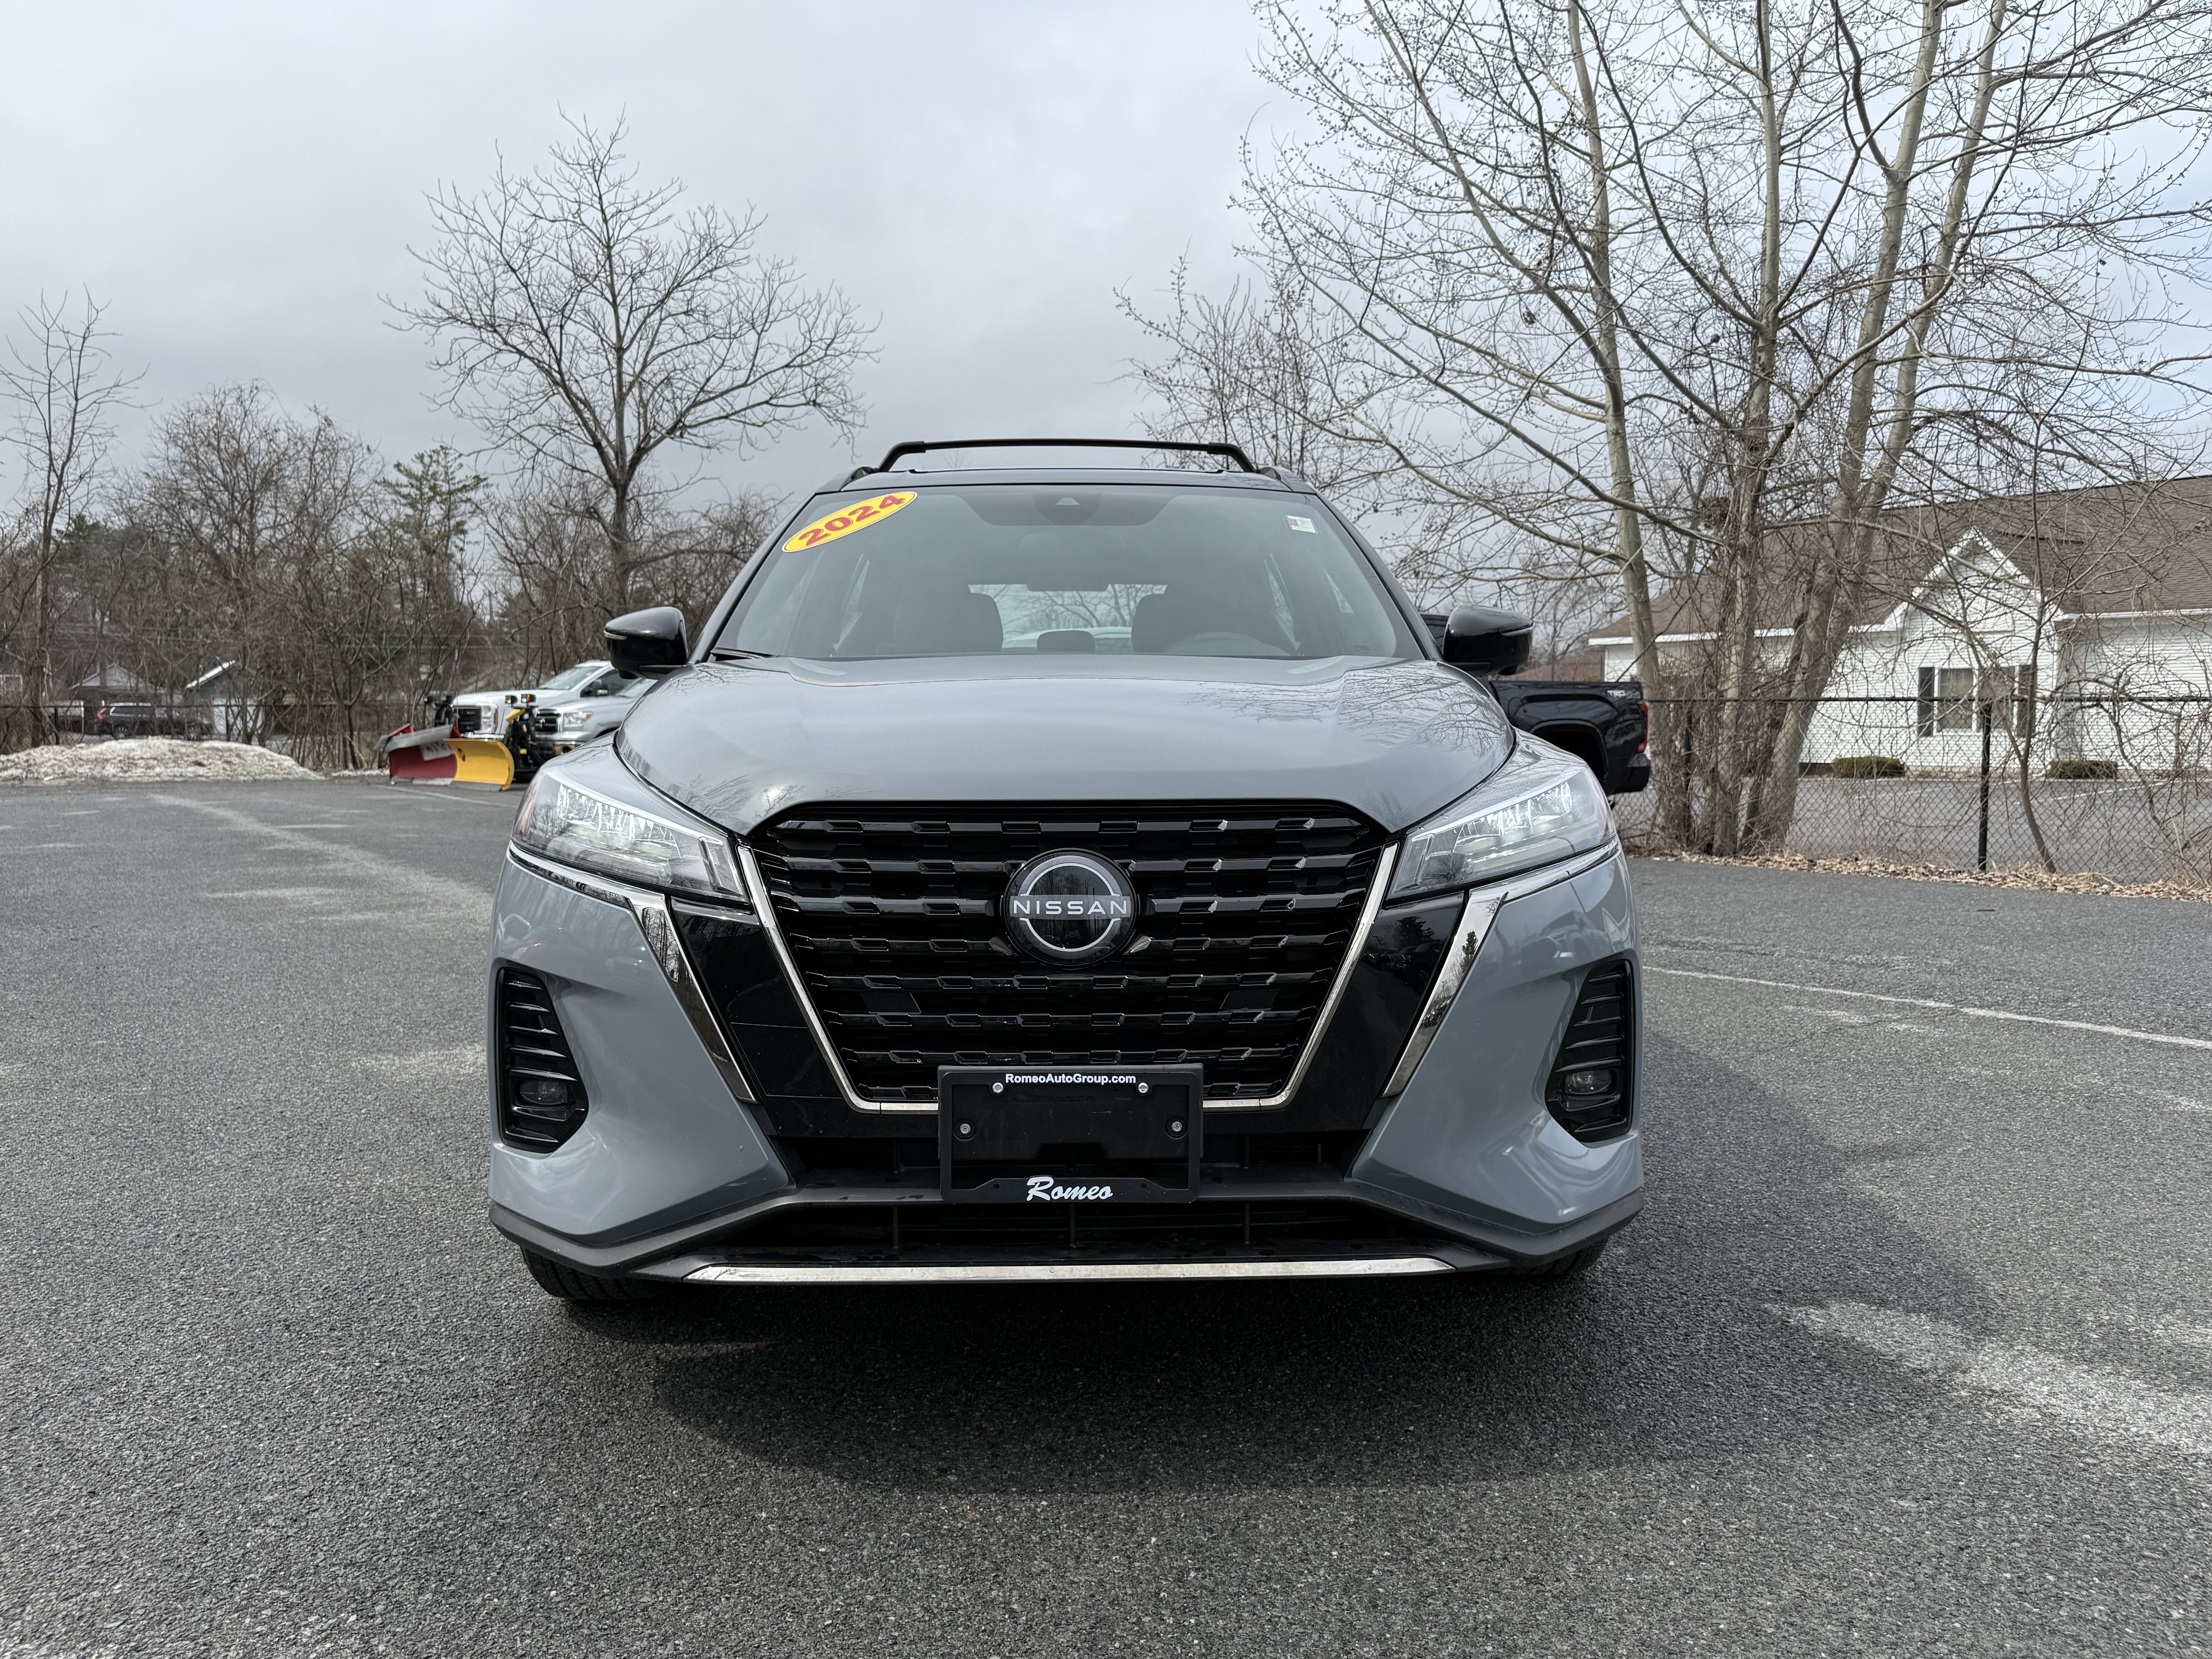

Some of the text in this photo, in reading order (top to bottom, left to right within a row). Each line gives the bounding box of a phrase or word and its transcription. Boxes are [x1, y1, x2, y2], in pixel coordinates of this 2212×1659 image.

[799, 495, 906, 546] 2024
[1607, 690, 1625, 698] TRD
[1013, 900, 1127, 915] NISSAN
[1005, 1073, 1136, 1085] RomeoAutoGroup.com
[1026, 1176, 1113, 1202] Romeo
